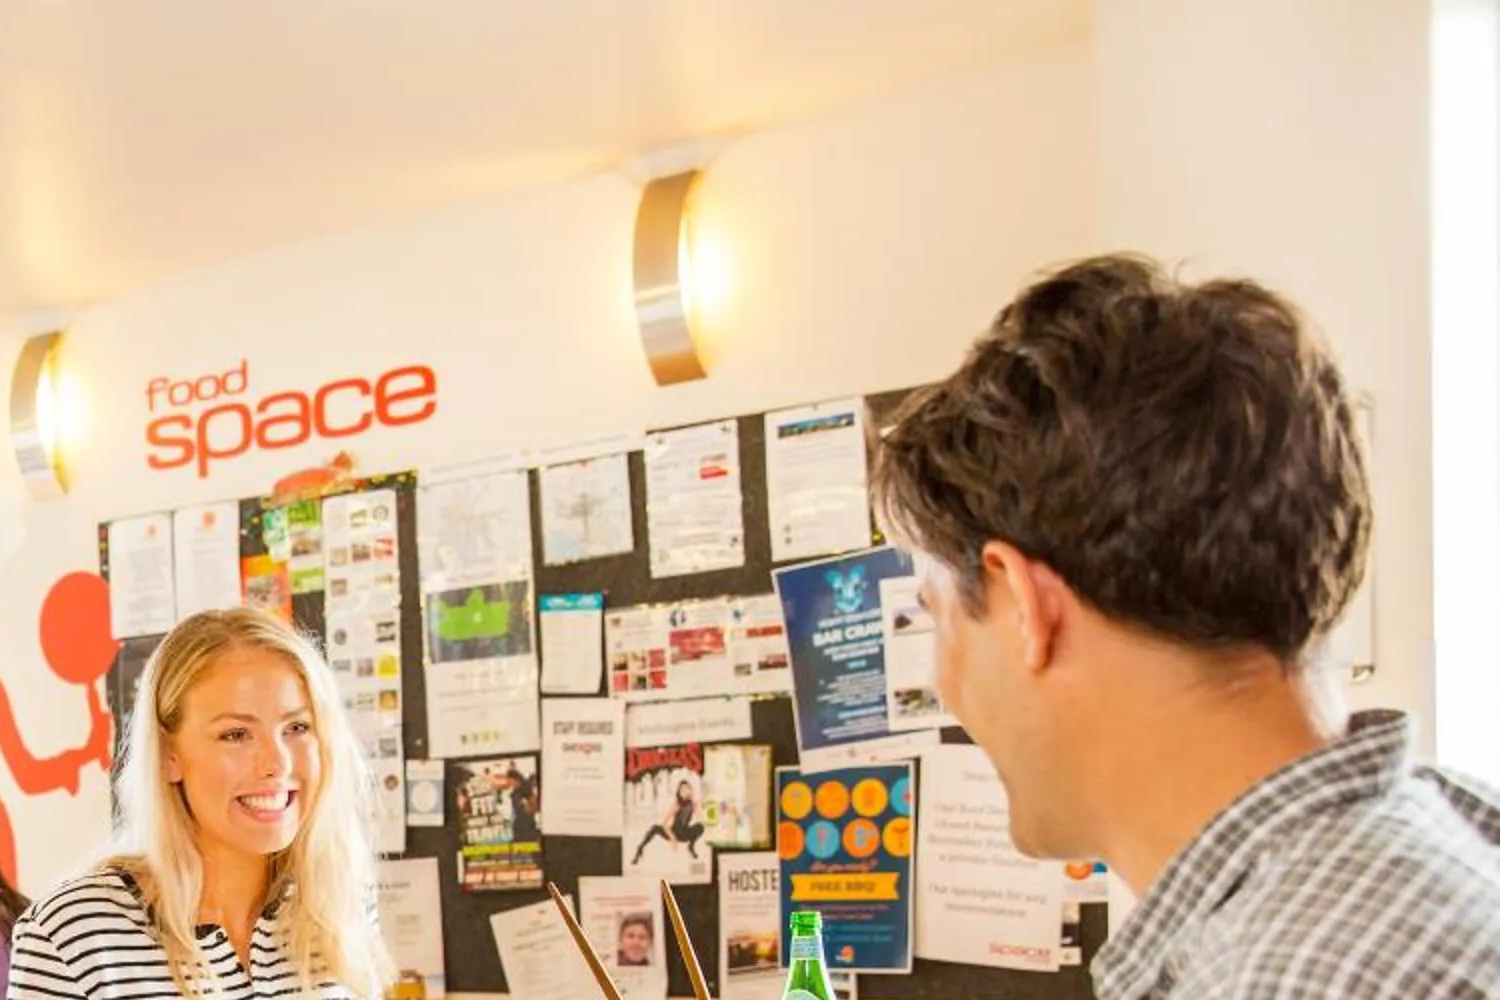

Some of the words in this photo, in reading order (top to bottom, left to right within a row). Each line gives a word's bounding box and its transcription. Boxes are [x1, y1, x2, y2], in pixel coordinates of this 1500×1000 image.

[145, 357, 248, 412] food
[146, 364, 437, 479] space
[728, 869, 778, 892] HOSTE
[810, 880, 843, 893] FREE
